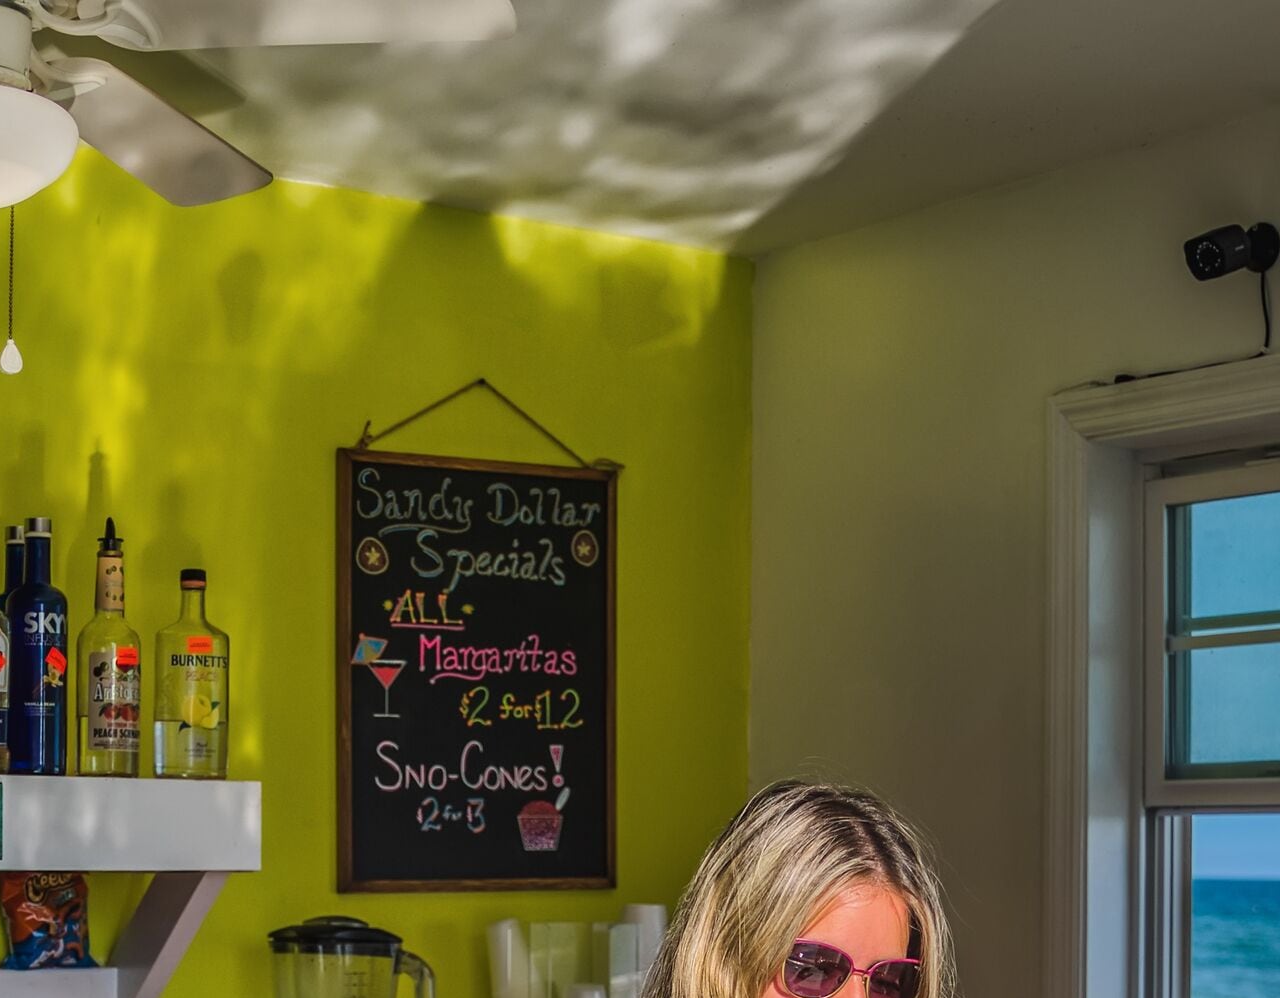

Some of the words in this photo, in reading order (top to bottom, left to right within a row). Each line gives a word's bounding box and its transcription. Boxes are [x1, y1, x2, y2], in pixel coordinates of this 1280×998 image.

[356, 467, 474, 537] Sandy
[486, 482, 600, 527] Dollar
[410, 529, 566, 594] Specials
[389, 589, 464, 624] ALL
[171, 653, 228, 669] BURNETT'S
[419, 633, 578, 684] Margaritas
[499, 693, 533, 721] for
[93, 727, 118, 740] PEACH
